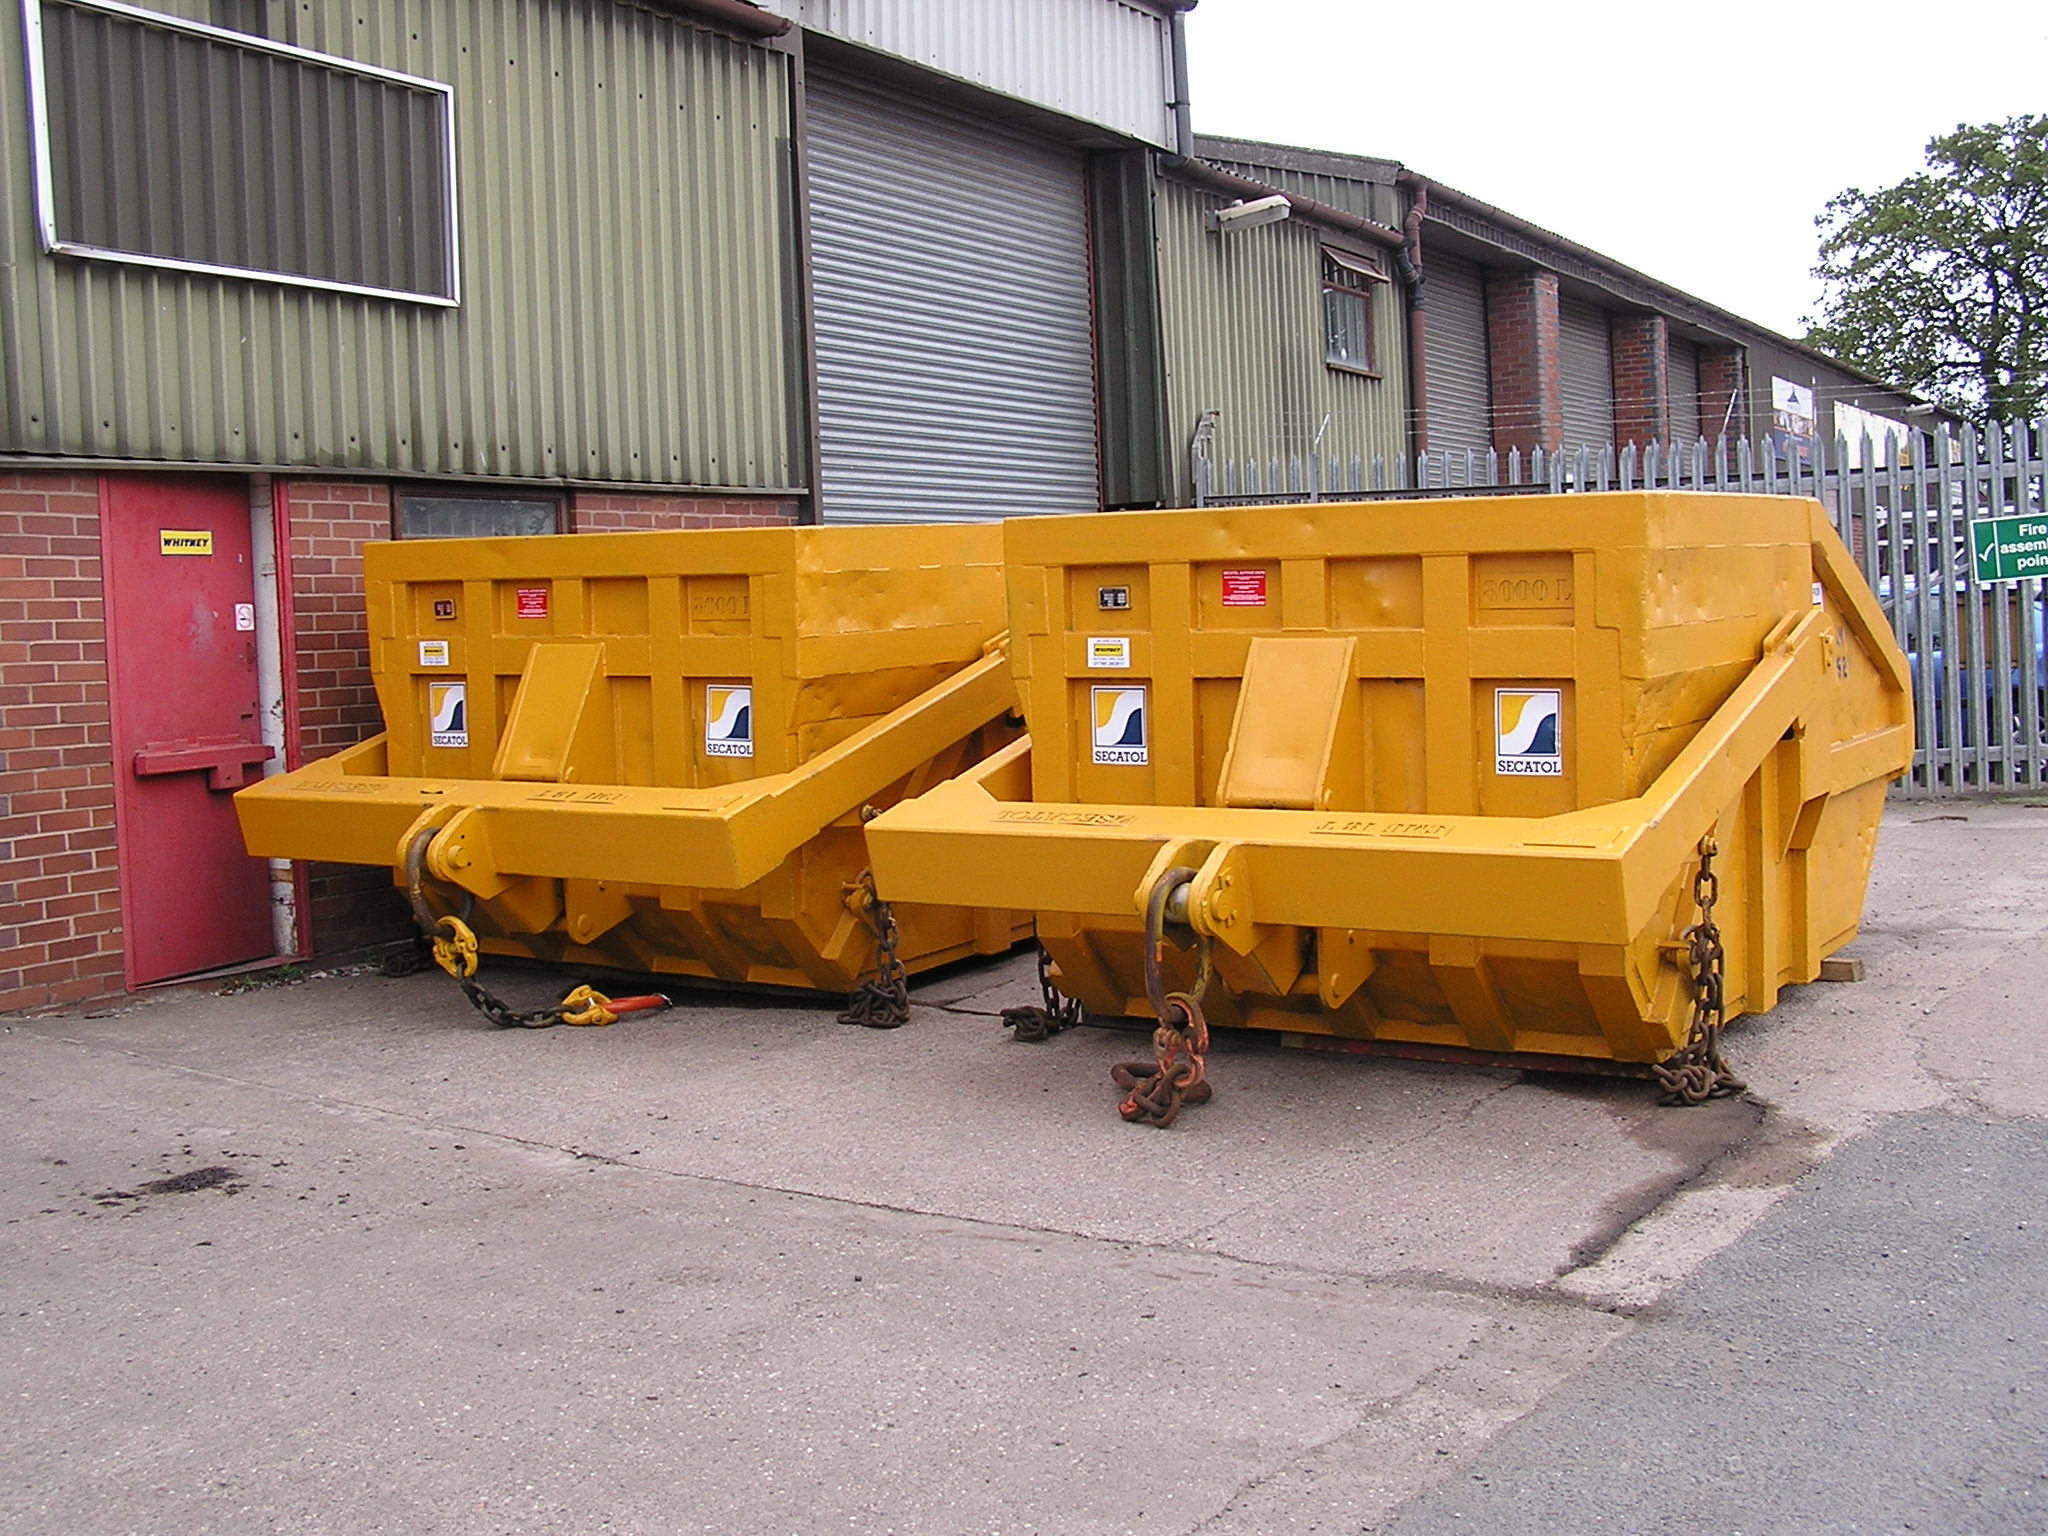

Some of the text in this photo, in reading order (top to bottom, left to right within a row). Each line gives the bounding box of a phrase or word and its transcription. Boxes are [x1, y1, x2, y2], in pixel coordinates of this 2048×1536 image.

[2018, 523, 2047, 537] Fire
[163, 538, 209, 547] WHITNEY
[2000, 537, 2048, 554] assem
[433, 735, 468, 745] SECATOL
[707, 743, 753, 755] SECATOL
[1095, 750, 1147, 763] SECATOL
[1498, 760, 1561, 774] SECATOL
